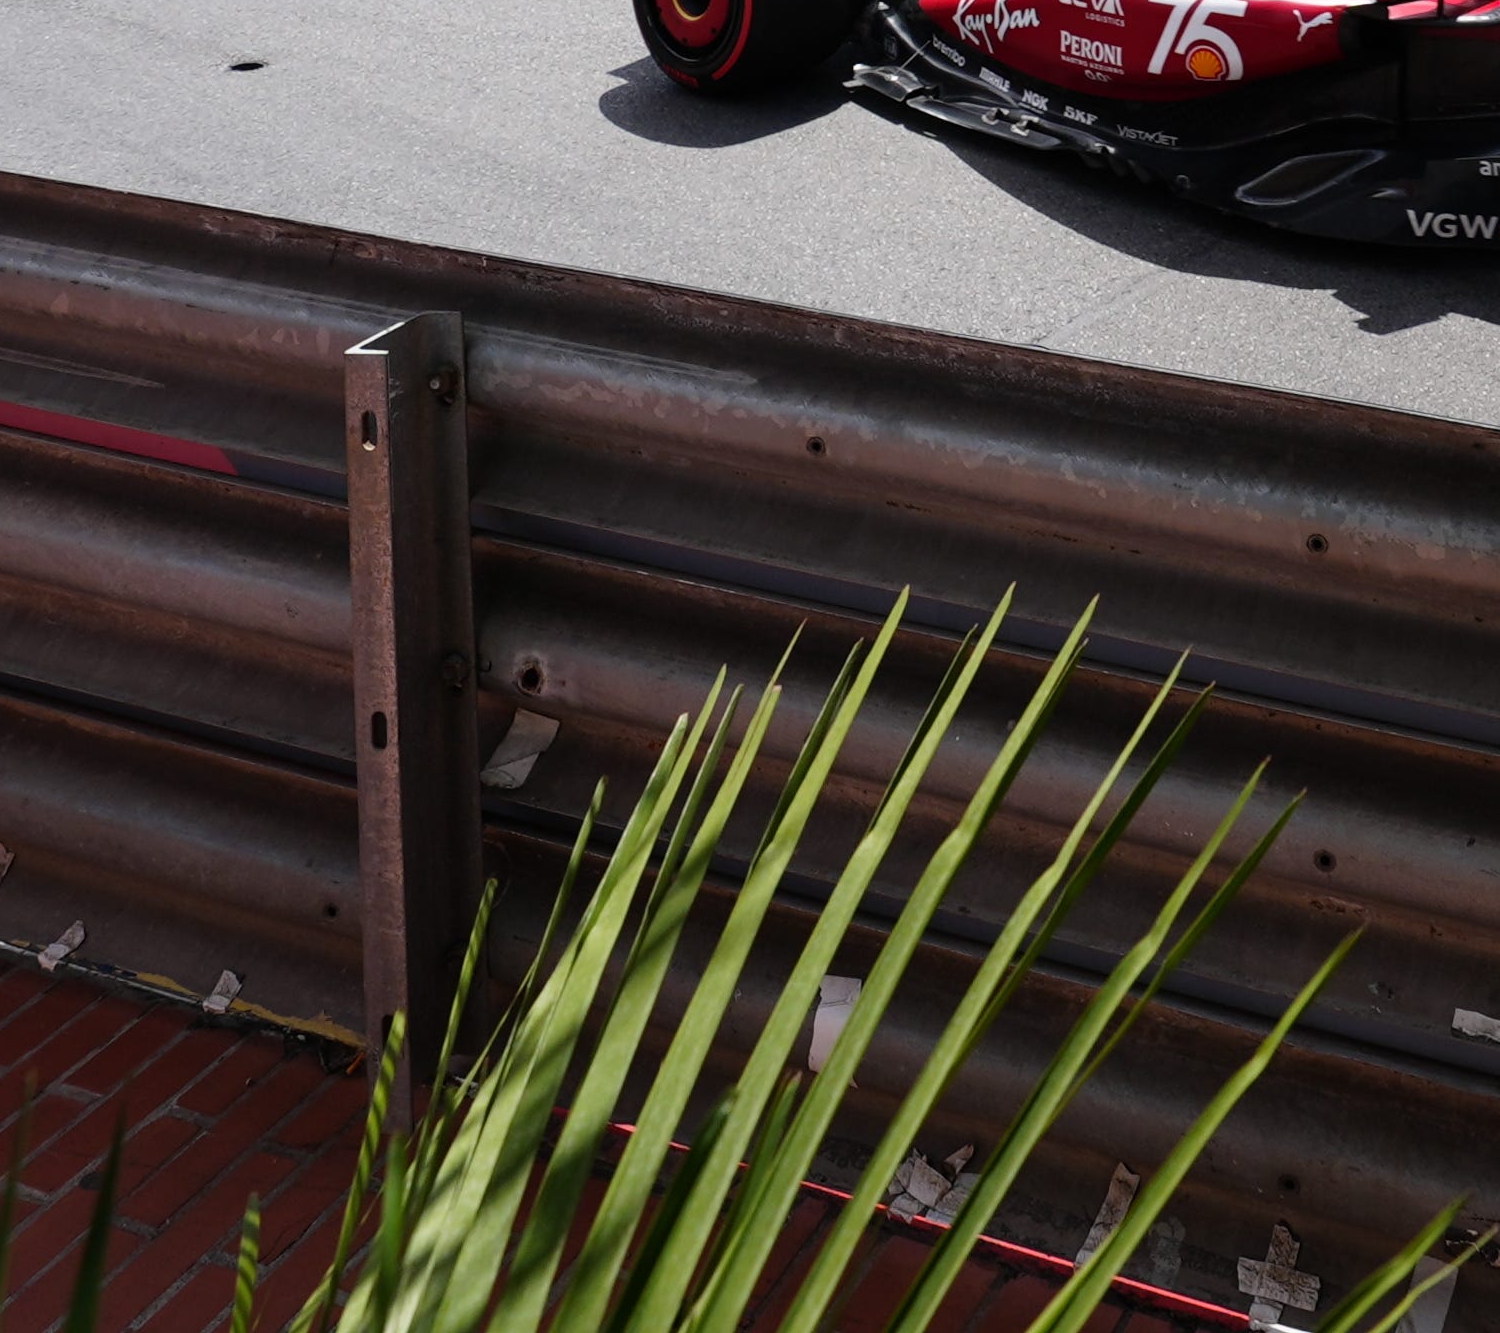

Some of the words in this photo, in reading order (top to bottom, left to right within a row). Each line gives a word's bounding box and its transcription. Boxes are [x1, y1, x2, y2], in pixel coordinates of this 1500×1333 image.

[1085, 12, 1125, 28] LOGISTICS
[932, 34, 966, 68] brembo
[1060, 29, 1123, 67] PERONI
[1021, 88, 1048, 111] NGK
[1063, 105, 1099, 126] SKF
[1405, 209, 1499, 239] VGW
